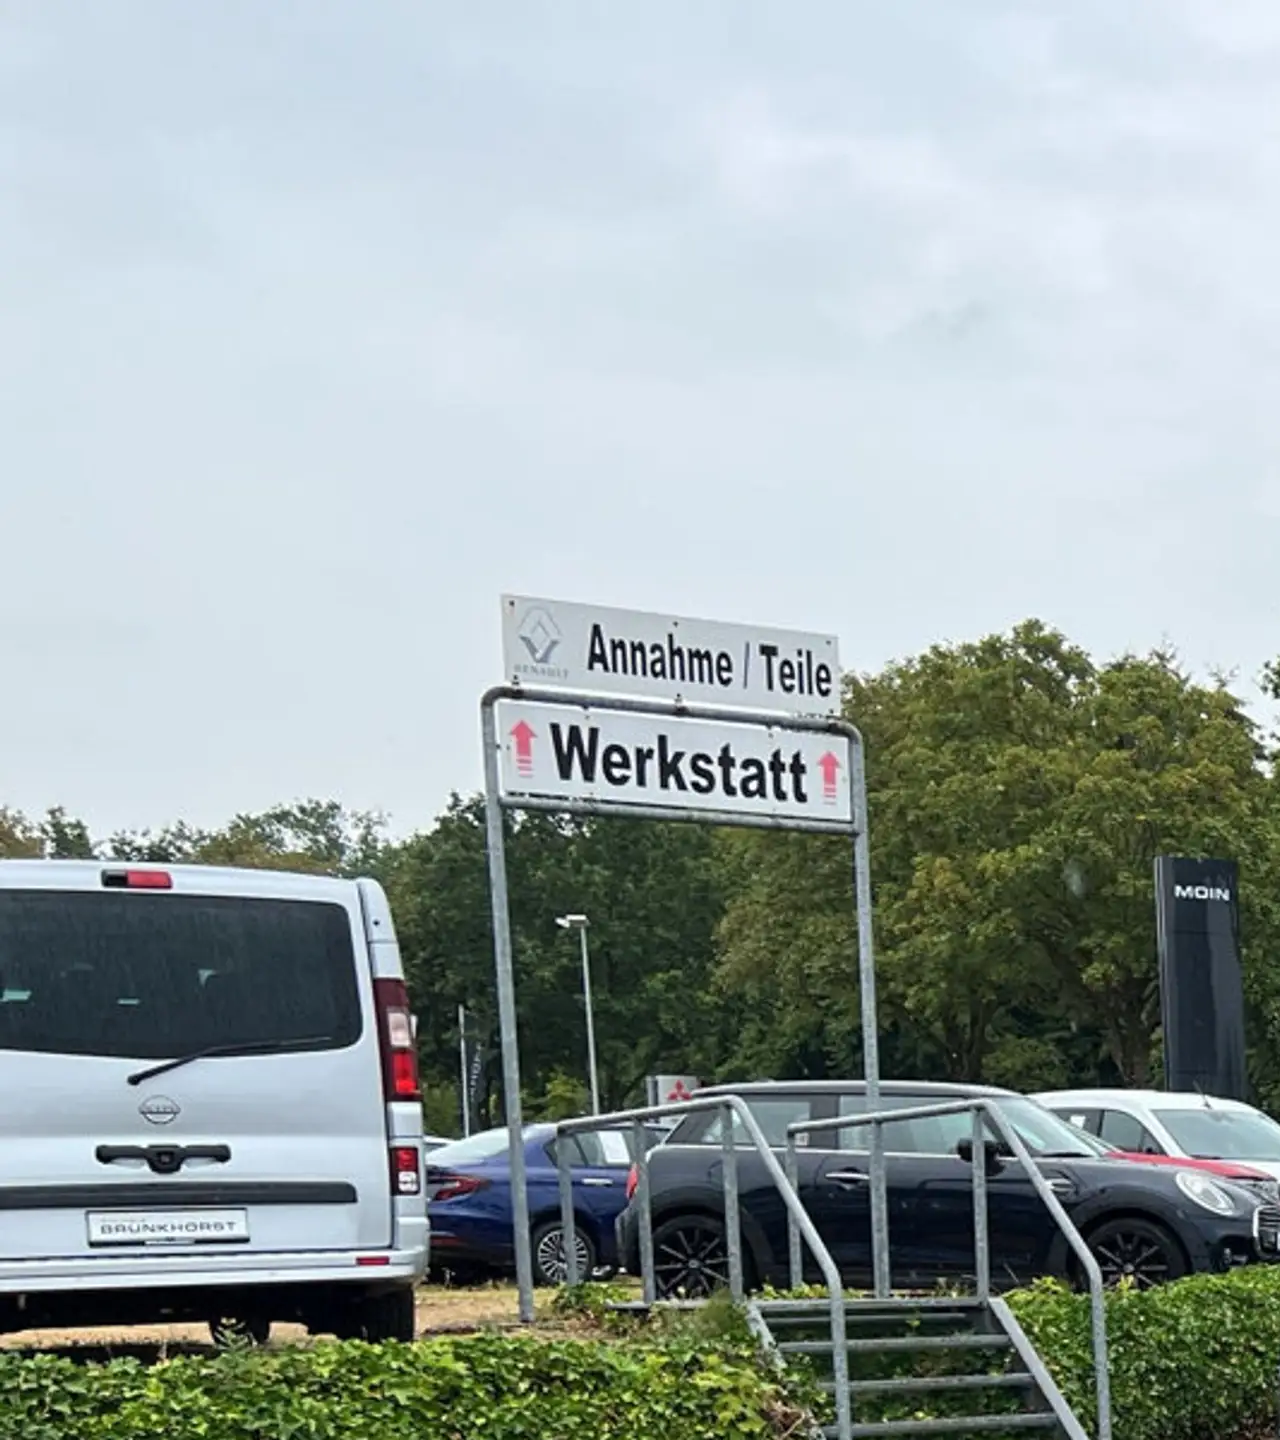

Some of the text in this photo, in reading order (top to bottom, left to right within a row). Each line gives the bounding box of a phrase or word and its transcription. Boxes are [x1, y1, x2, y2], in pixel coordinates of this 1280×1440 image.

[587, 623, 832, 697] Annahme / Teile
[549, 722, 808, 803] Werkstatt
[1174, 885, 1231, 901] MOIN
